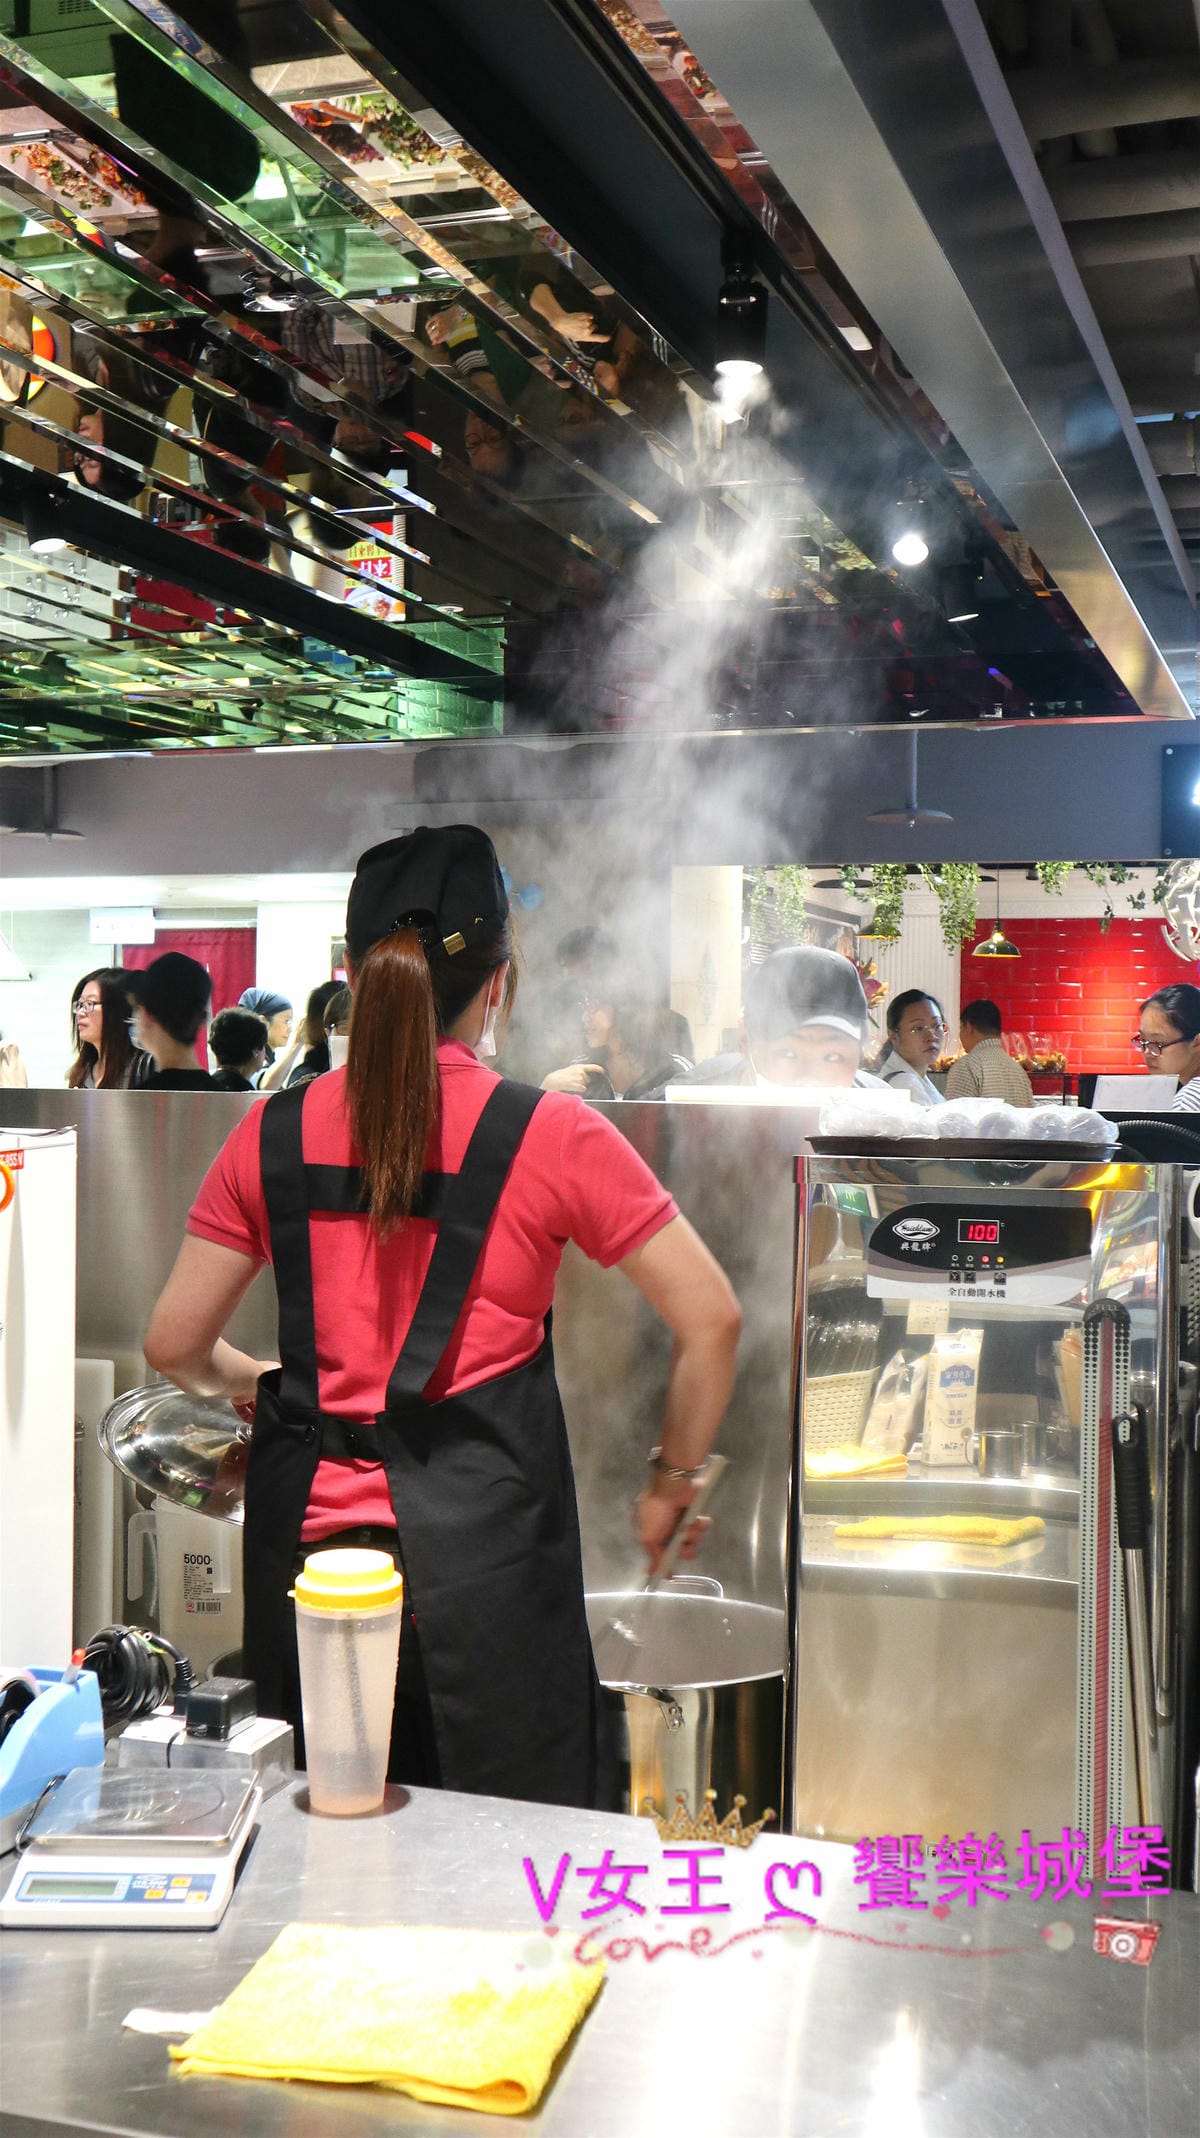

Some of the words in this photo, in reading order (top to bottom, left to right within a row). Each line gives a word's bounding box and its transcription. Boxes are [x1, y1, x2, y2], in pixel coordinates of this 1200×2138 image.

[967, 1223, 999, 1242] 100
[948, 1287, 1006, 1299] 全自動開水機
[184, 1553, 211, 1565] 5000
